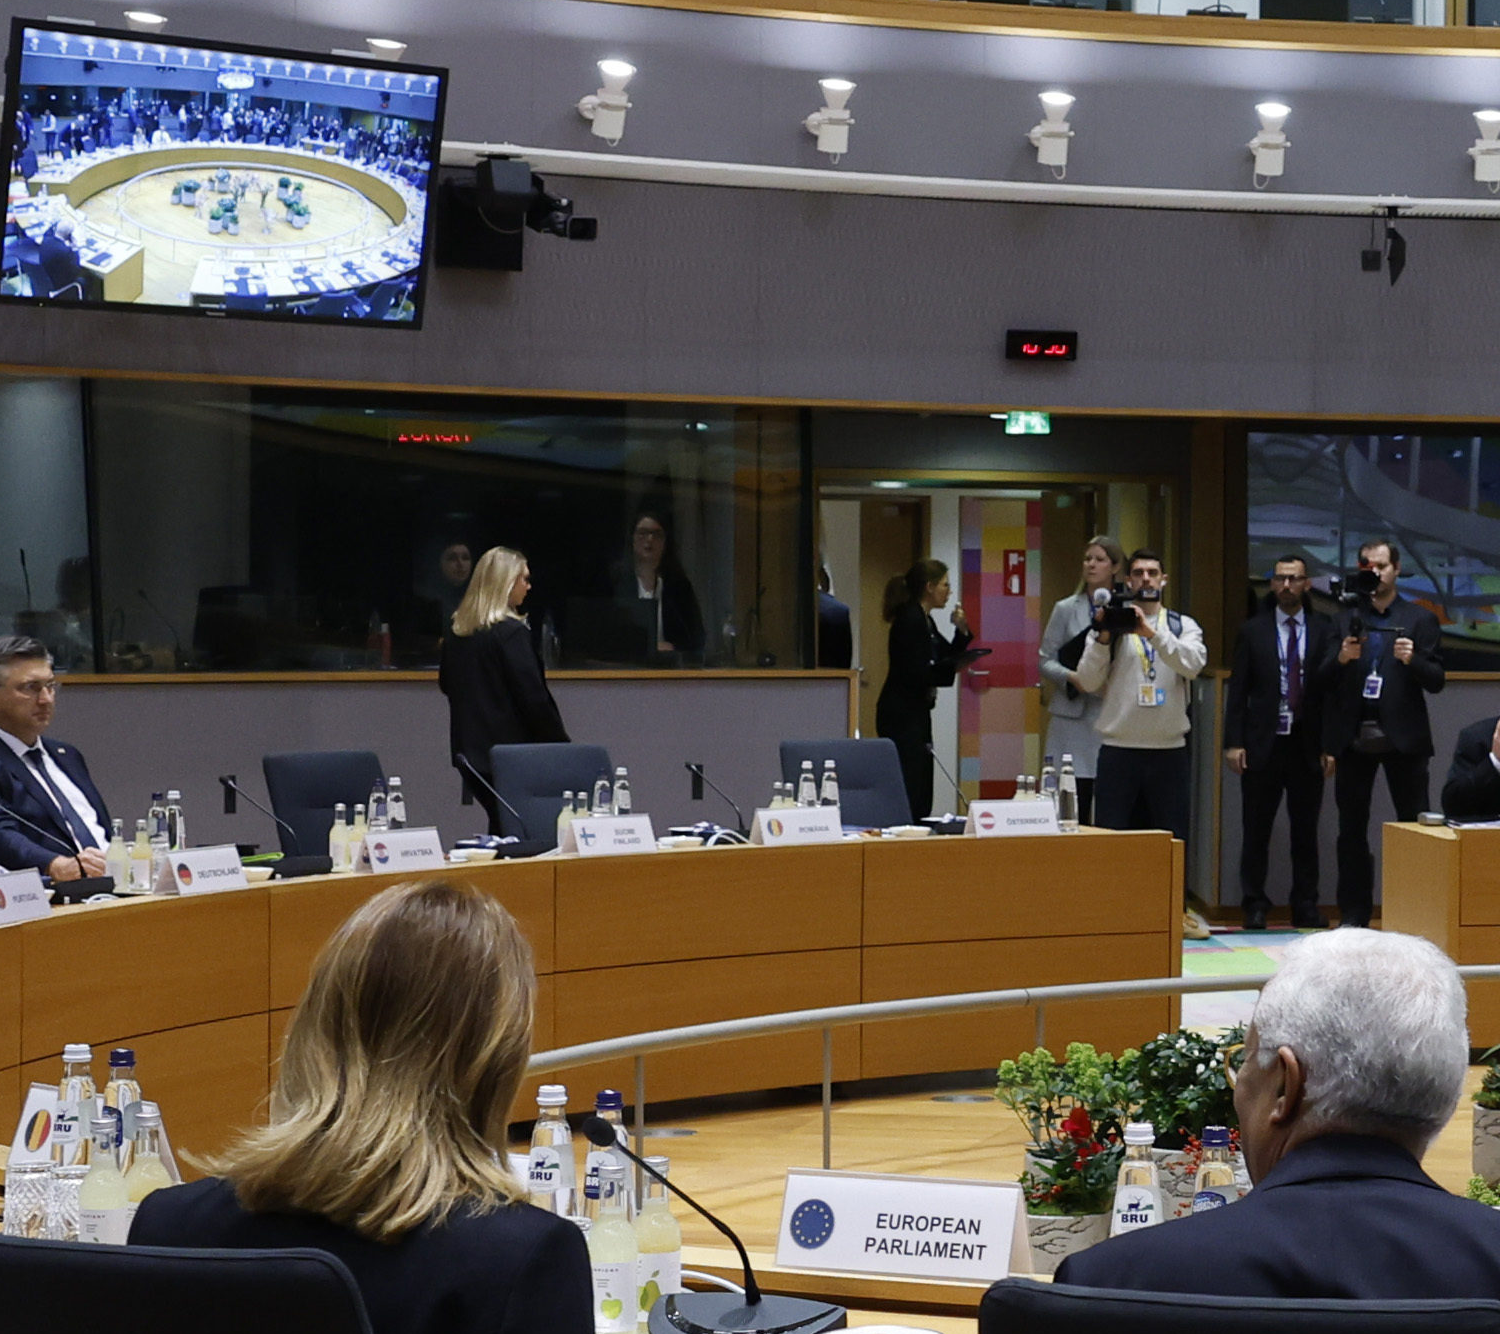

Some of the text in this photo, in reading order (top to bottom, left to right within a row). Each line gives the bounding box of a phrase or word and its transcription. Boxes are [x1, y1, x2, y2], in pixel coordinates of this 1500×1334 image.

[1006, 817, 1050, 826] ÖSTERREICH
[197, 866, 240, 879] DEUTSCHLAND
[529, 1171, 553, 1181] BRU
[875, 1213, 982, 1235] EUROPEAN
[1120, 1213, 1149, 1224] BRU
[863, 1236, 988, 1261] PARLIAMENT
